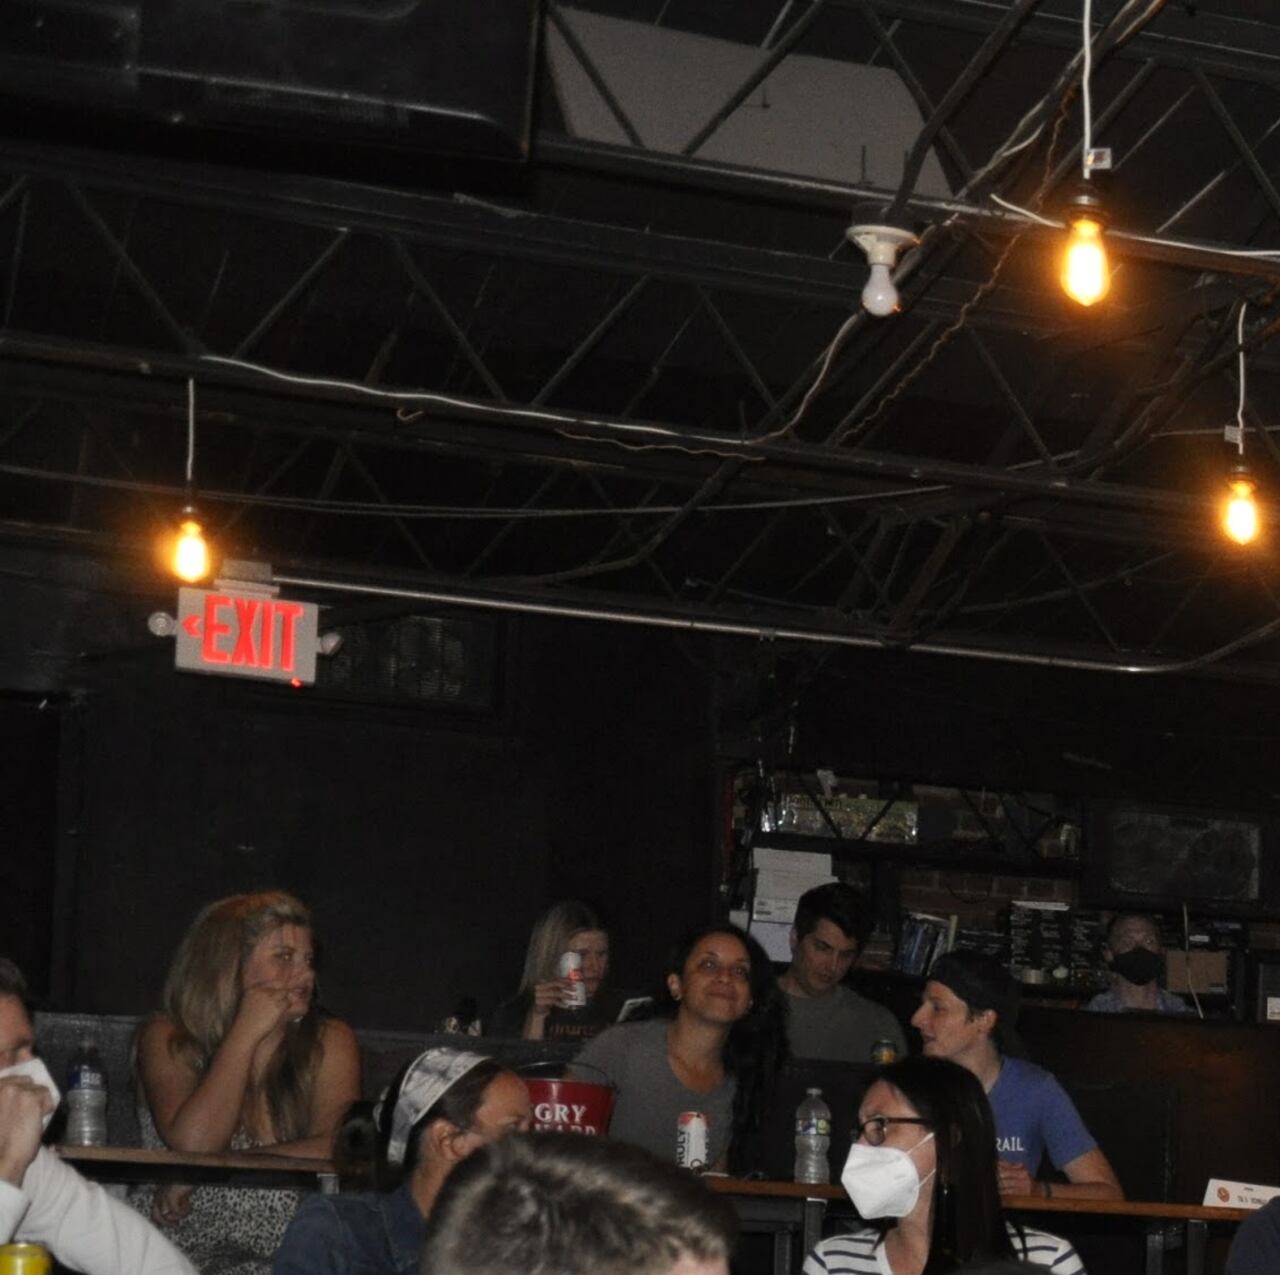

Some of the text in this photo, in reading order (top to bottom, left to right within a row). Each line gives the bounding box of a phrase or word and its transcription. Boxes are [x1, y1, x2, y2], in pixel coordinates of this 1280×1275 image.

[202, 594, 304, 672] EXIT
[534, 1103, 587, 1123] GRY
[675, 1130, 686, 1166] RULY
